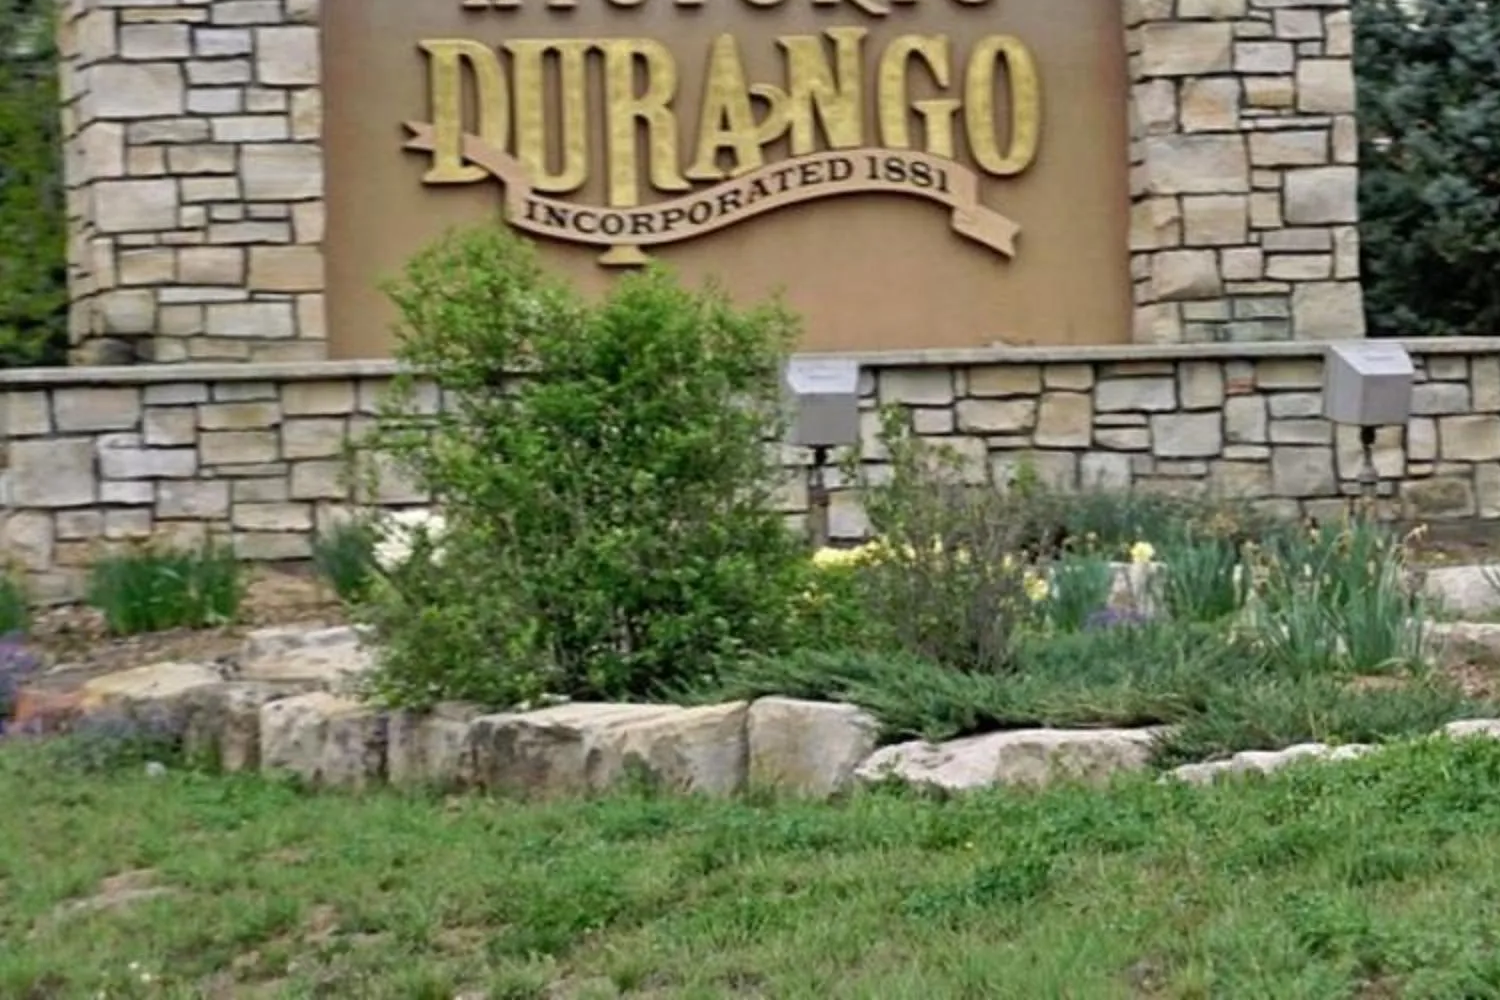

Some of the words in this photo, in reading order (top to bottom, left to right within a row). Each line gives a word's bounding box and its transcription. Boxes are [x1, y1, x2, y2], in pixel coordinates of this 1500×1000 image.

[417, 26, 1042, 264] DURANGO
[522, 156, 854, 236] INCORPORATED
[866, 156, 950, 192] 1881
